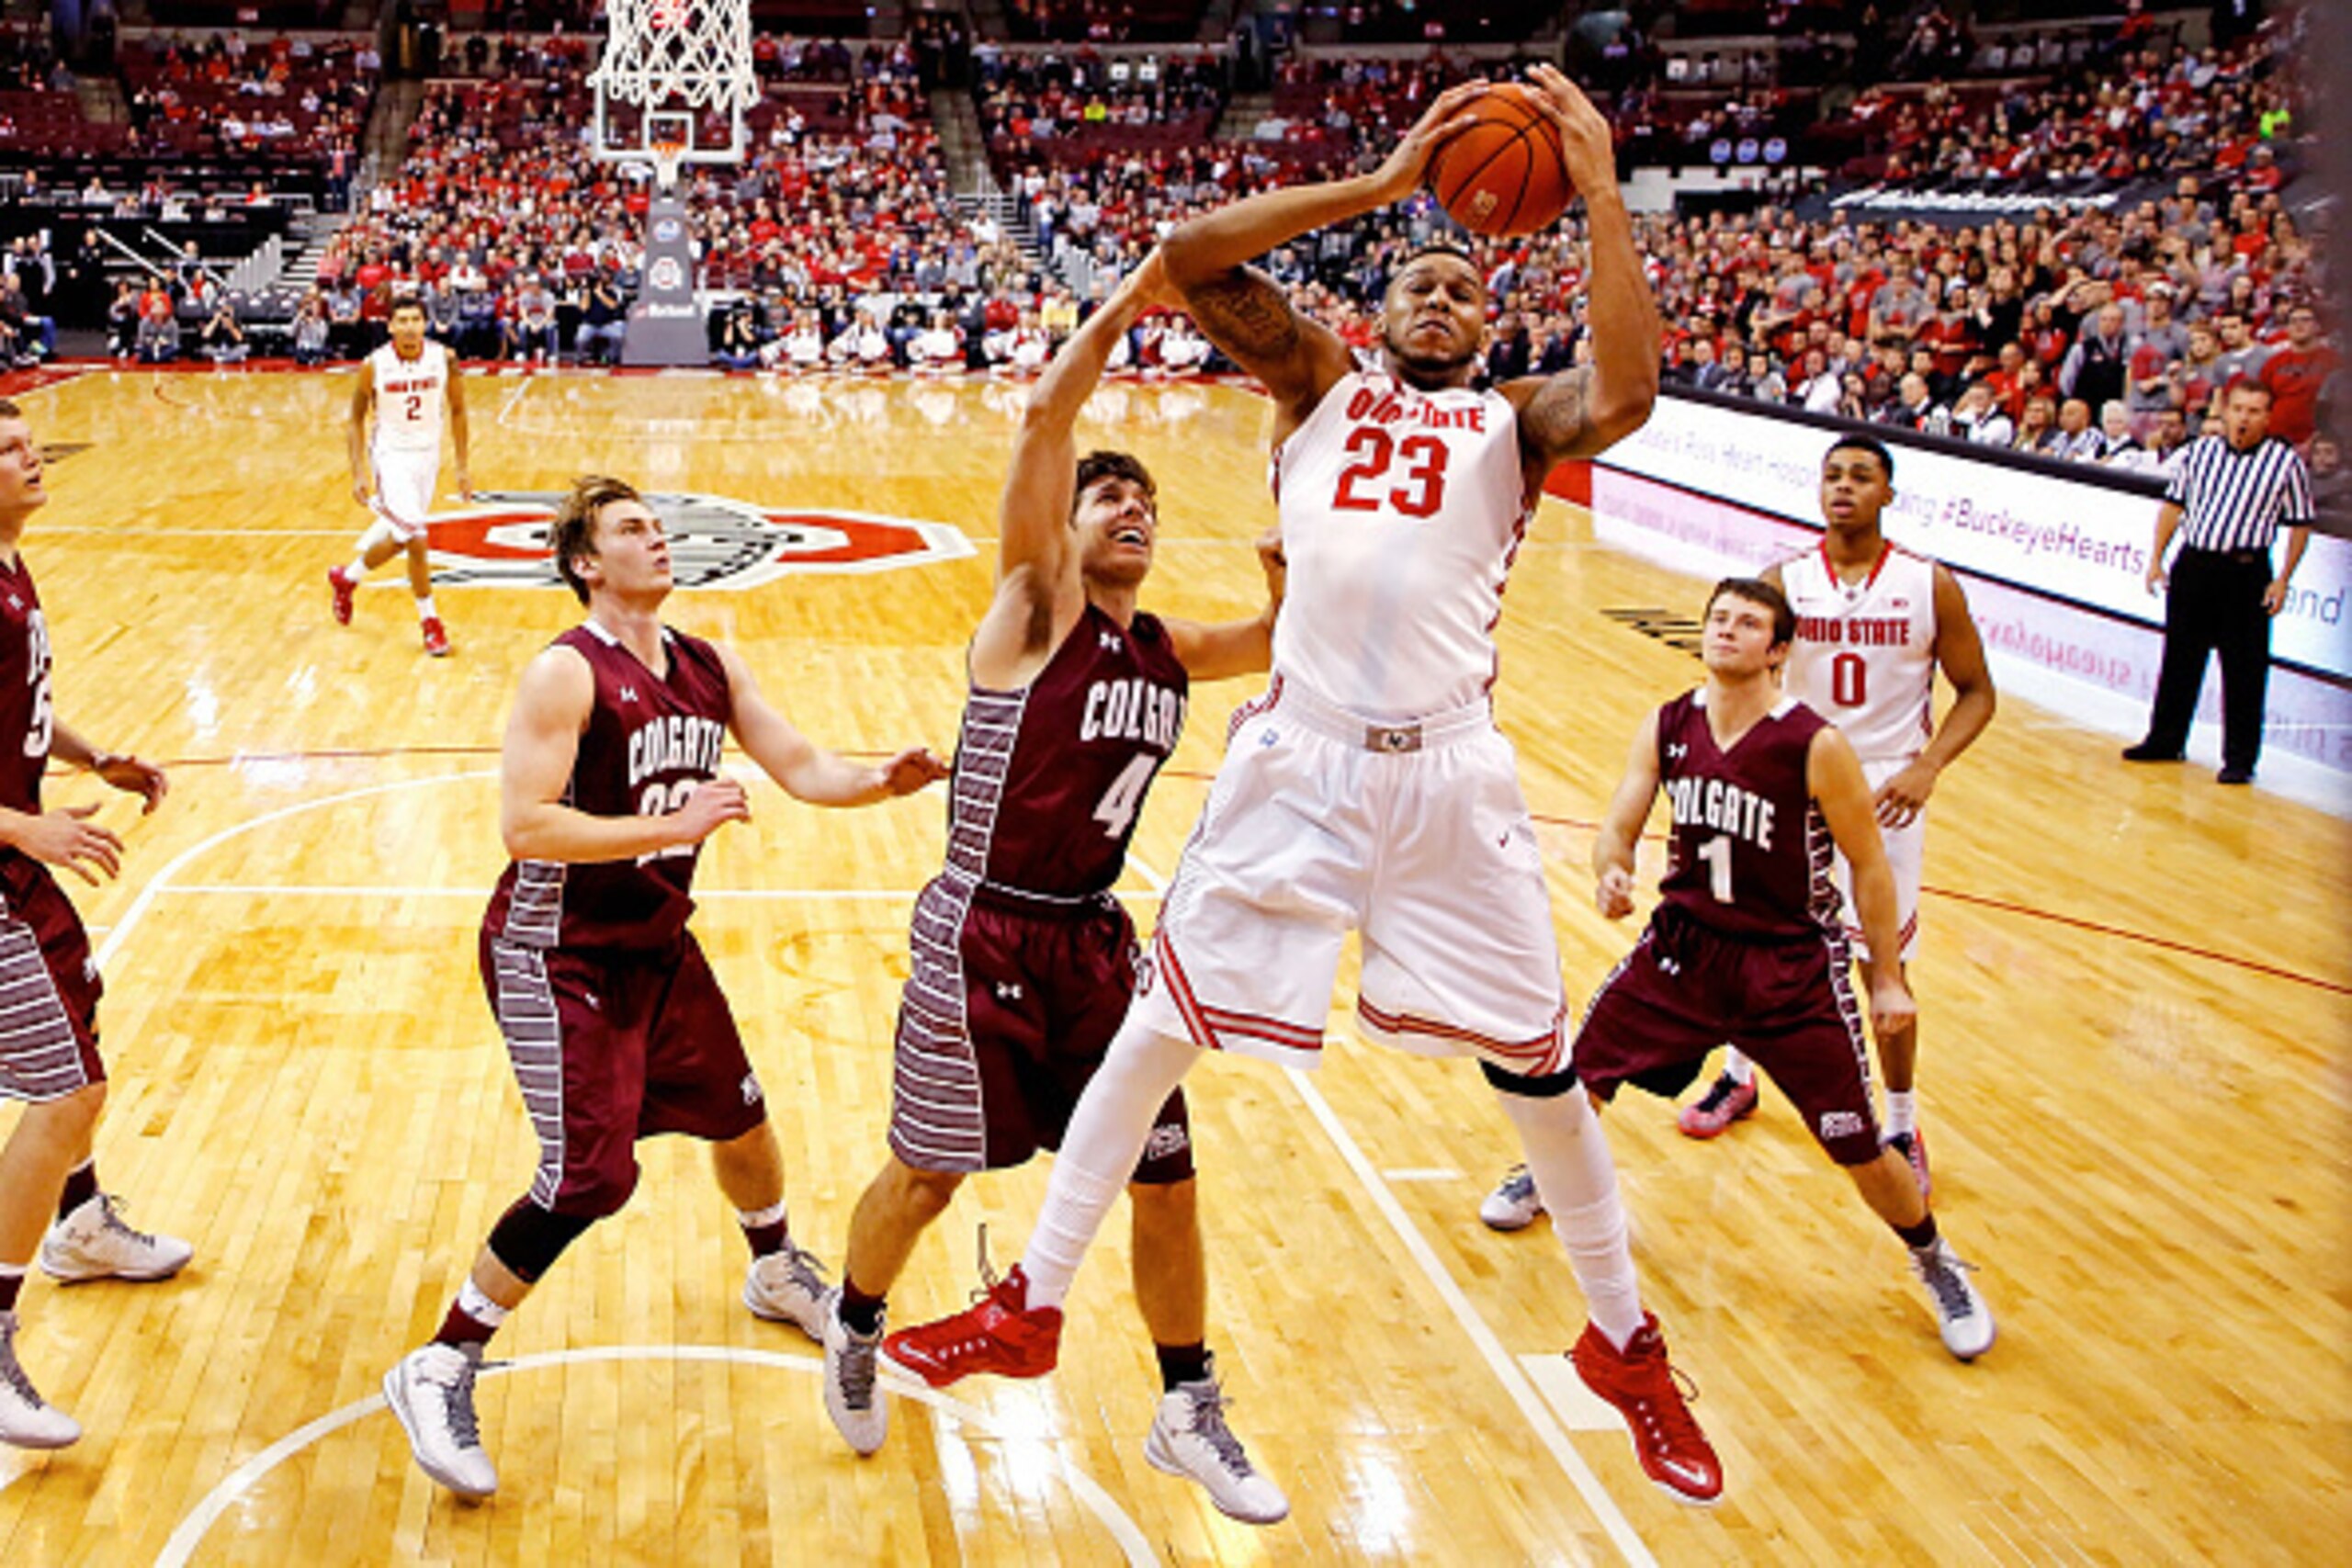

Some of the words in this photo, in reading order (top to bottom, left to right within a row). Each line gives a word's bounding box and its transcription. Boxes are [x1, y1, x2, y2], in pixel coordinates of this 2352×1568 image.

[405, 395, 422, 421] 2
[1331, 426, 1449, 518] 23
[1942, 498, 2145, 576] #BuckeyeHearts
[1848, 616, 1910, 646] STATE
[1832, 651, 1866, 707] 0
[1092, 751, 1158, 840] 4
[1697, 835, 1735, 905] 1
